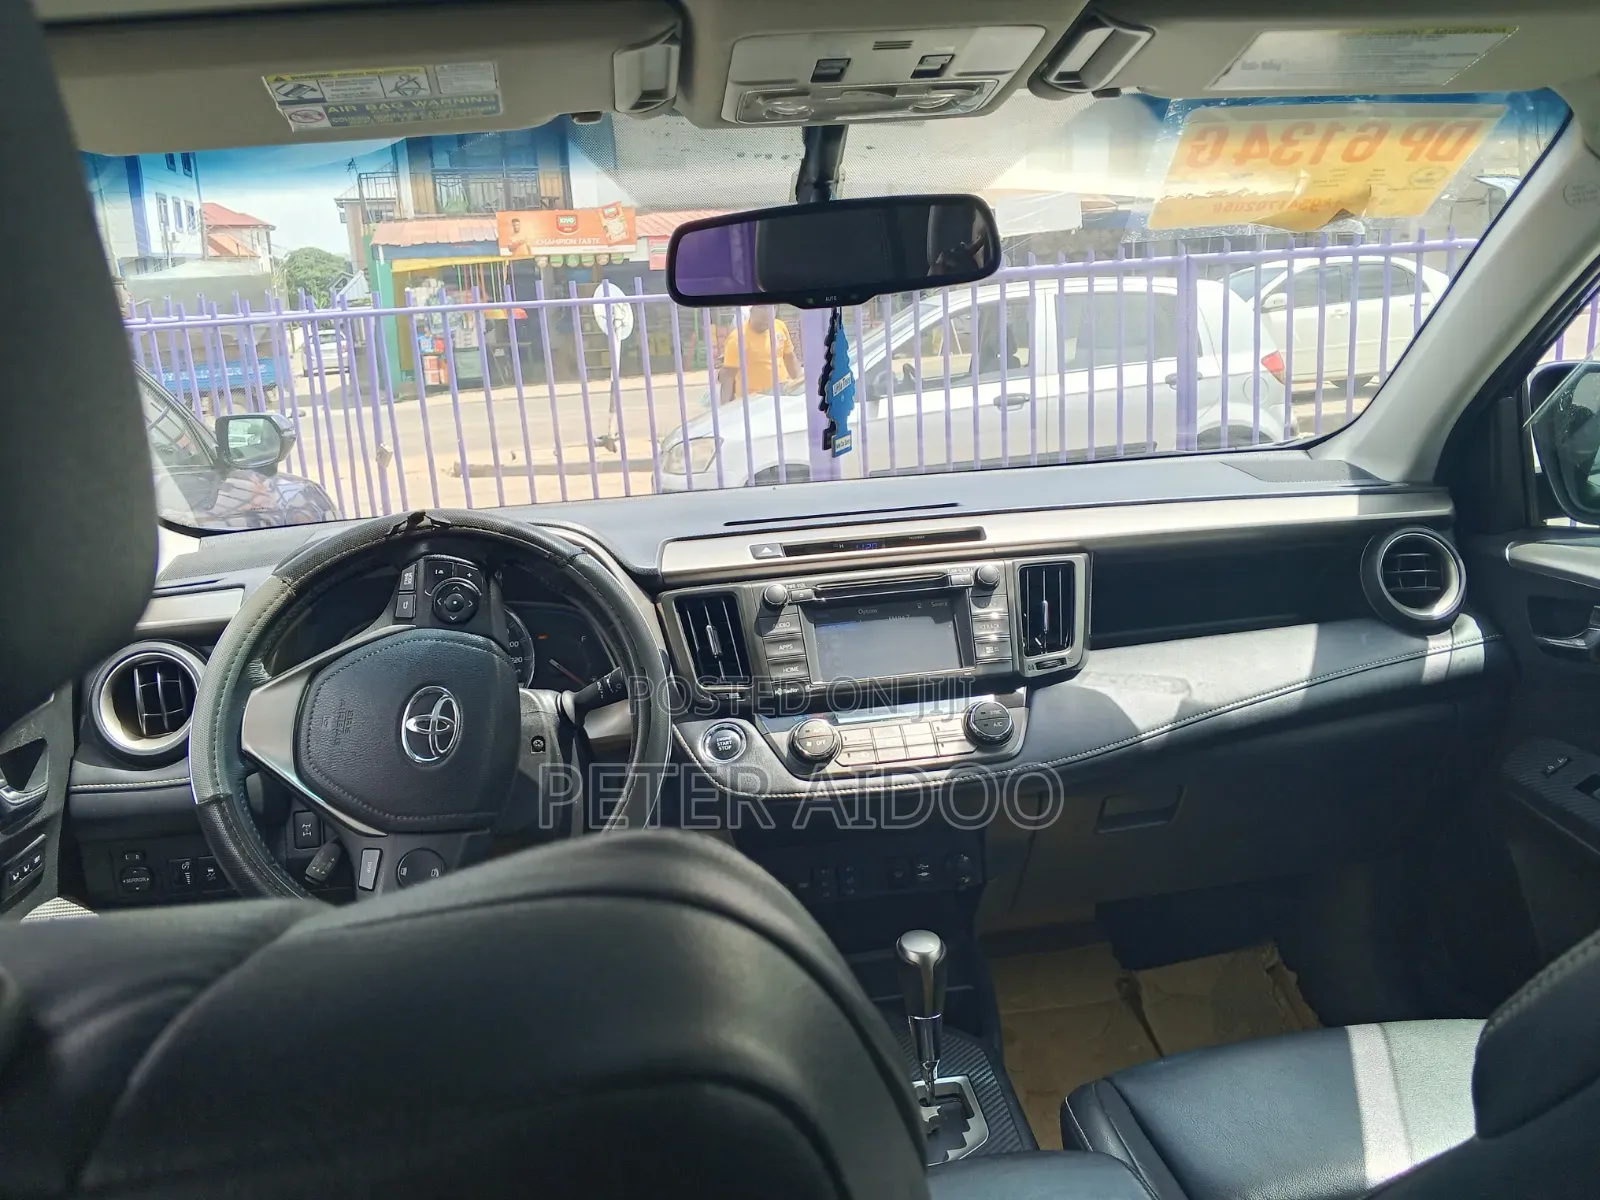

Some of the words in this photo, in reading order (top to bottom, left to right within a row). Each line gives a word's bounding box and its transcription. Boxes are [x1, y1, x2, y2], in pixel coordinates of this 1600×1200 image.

[328, 105, 357, 113] AIR
[365, 102, 404, 111] BAG
[411, 96, 496, 108] WARNING
[535, 237, 577, 246] CHAMPION
[578, 237, 601, 245] TASTE
[778, 643, 793, 651] APPS
[782, 666, 800, 674] HOME
